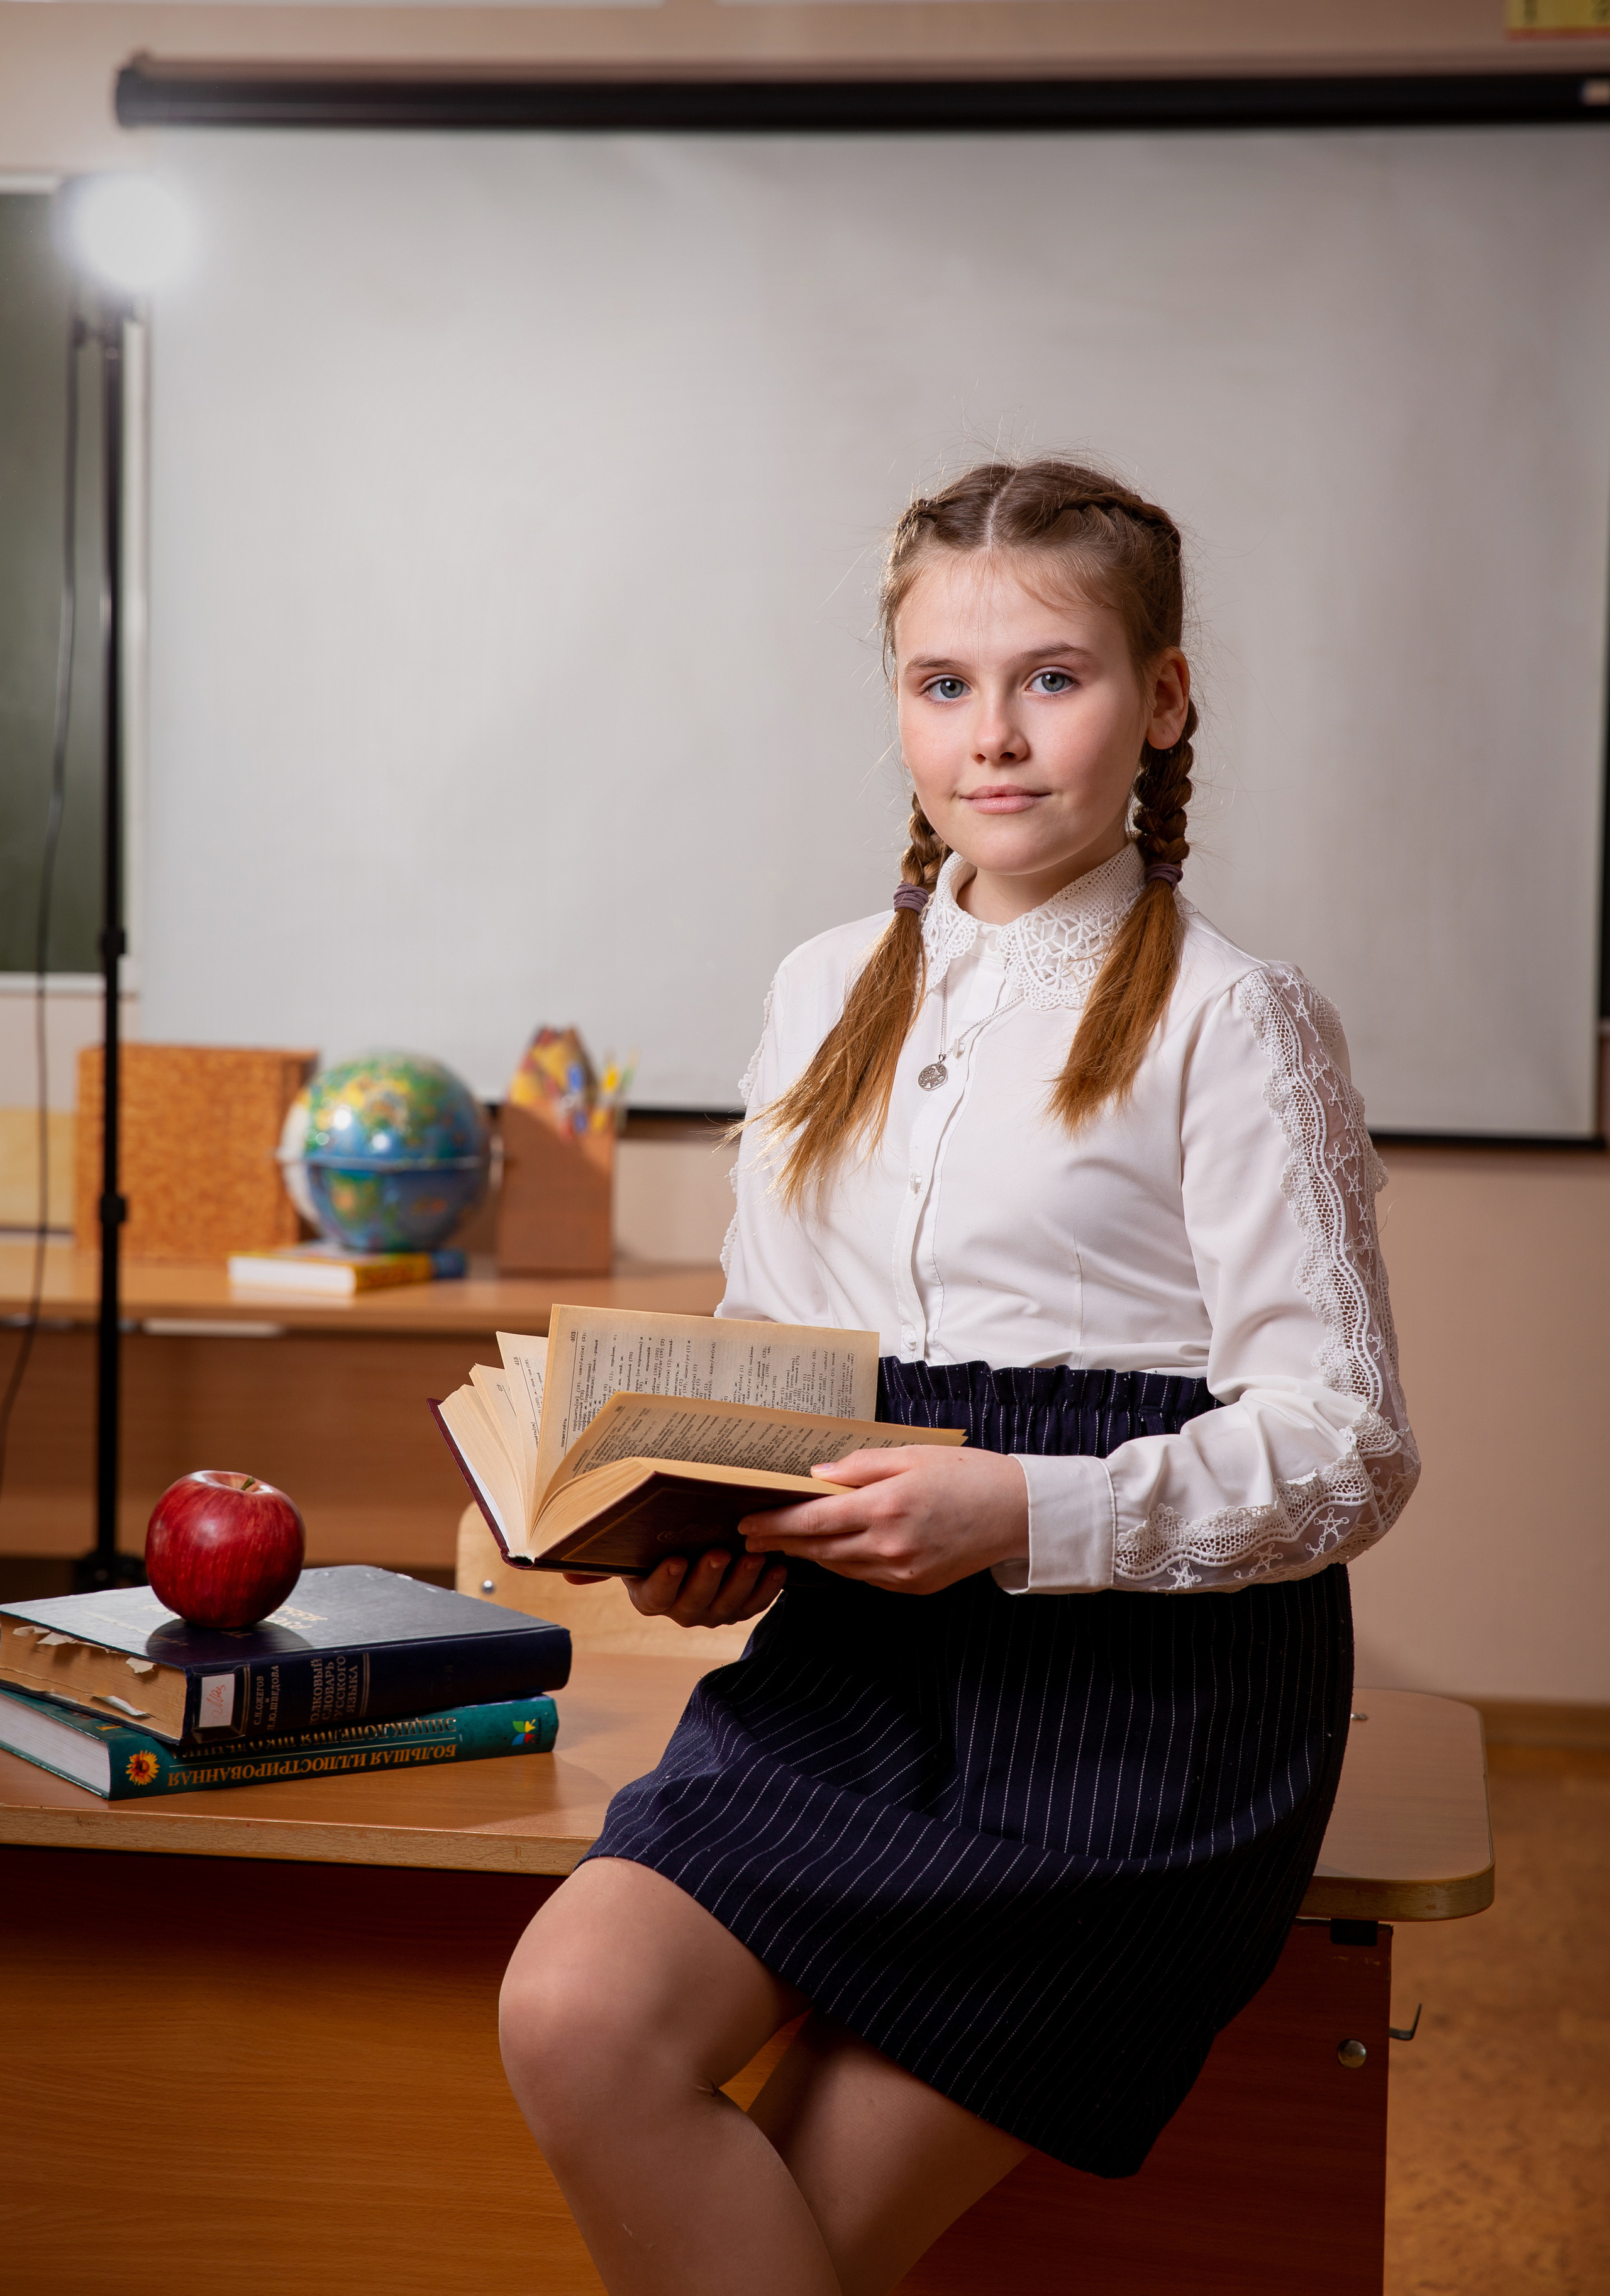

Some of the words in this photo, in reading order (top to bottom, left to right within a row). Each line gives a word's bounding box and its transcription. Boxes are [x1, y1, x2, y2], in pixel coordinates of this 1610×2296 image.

[322, 1661, 335, 1720] СЛОВАРЬ
[333, 1656, 346, 1720] УССКОГО
[346, 1665, 358, 1712] ЯЗЫКА
[300, 1717, 457, 1746] ЭНЦИКЛОПЕДИЯ
[167, 1753, 367, 1786] ИЛЛЮСТРИРОВАННАЯ
[370, 1744, 458, 1765] БОЛЬШАЯ
